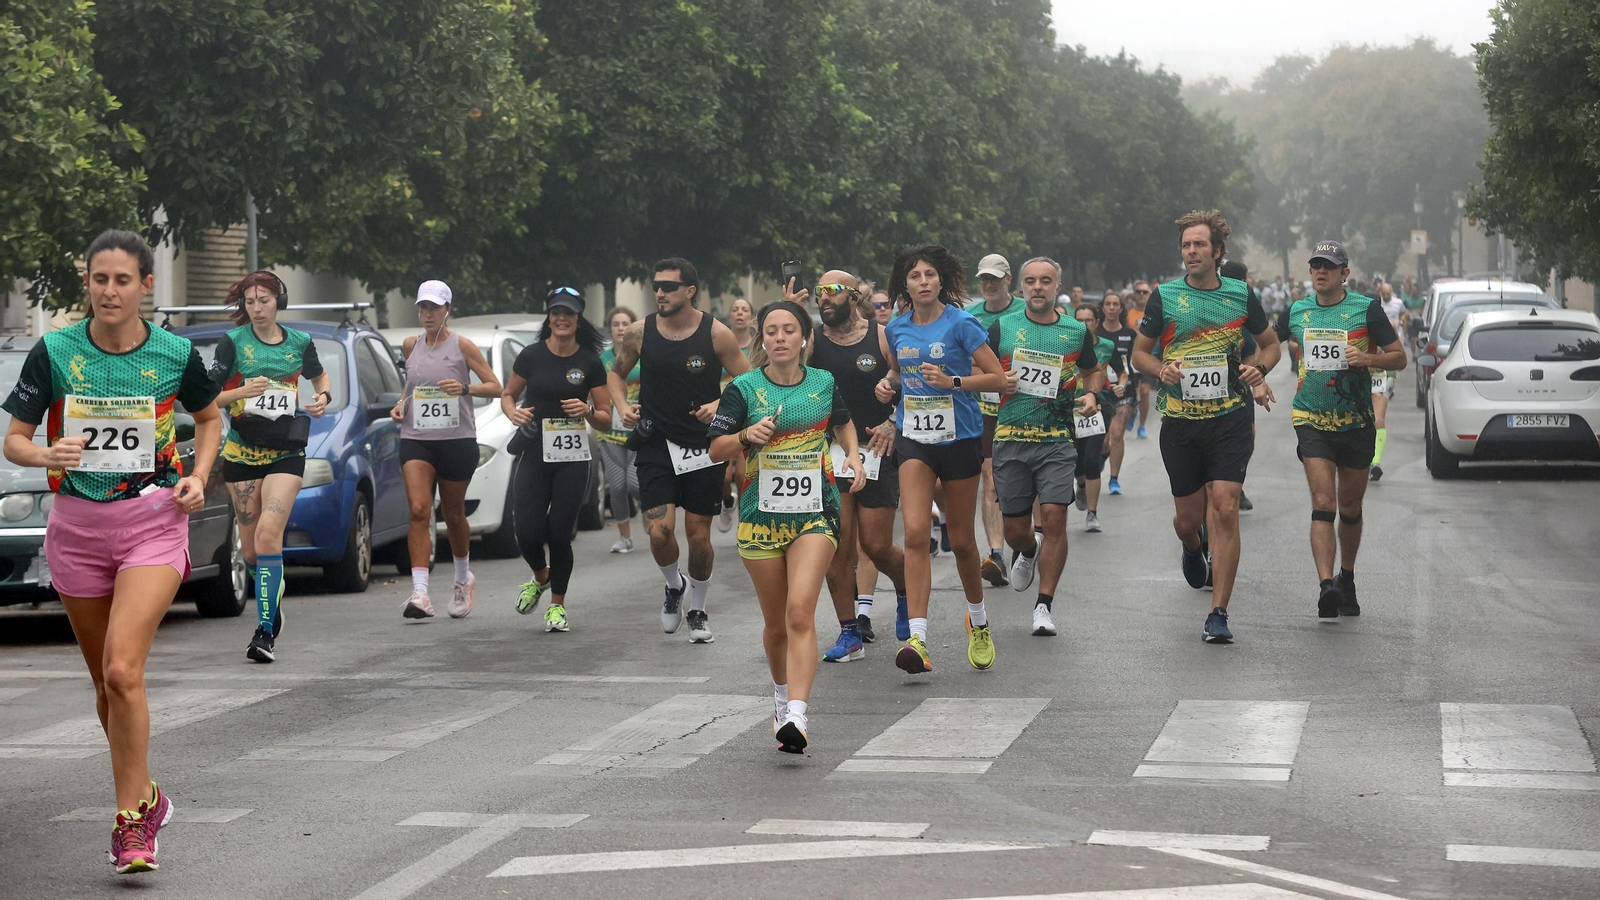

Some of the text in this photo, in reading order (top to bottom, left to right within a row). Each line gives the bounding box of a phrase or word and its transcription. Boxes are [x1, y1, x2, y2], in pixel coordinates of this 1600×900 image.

[1316, 244, 1338, 252] NAVY
[1311, 345, 1340, 359] 436
[1019, 366, 1052, 385] 278
[1190, 371, 1221, 388] 240
[1371, 378, 1383, 387] 90
[76, 398, 108, 406] CARRERA
[255, 394, 288, 411] 414
[421, 403, 451, 418] 261
[913, 414, 946, 431] 112
[1077, 416, 1099, 429] 426
[1516, 415, 1567, 426] 2855 FVZ
[82, 427, 140, 451] 226
[552, 434, 582, 450] 433
[771, 476, 812, 497] 299
